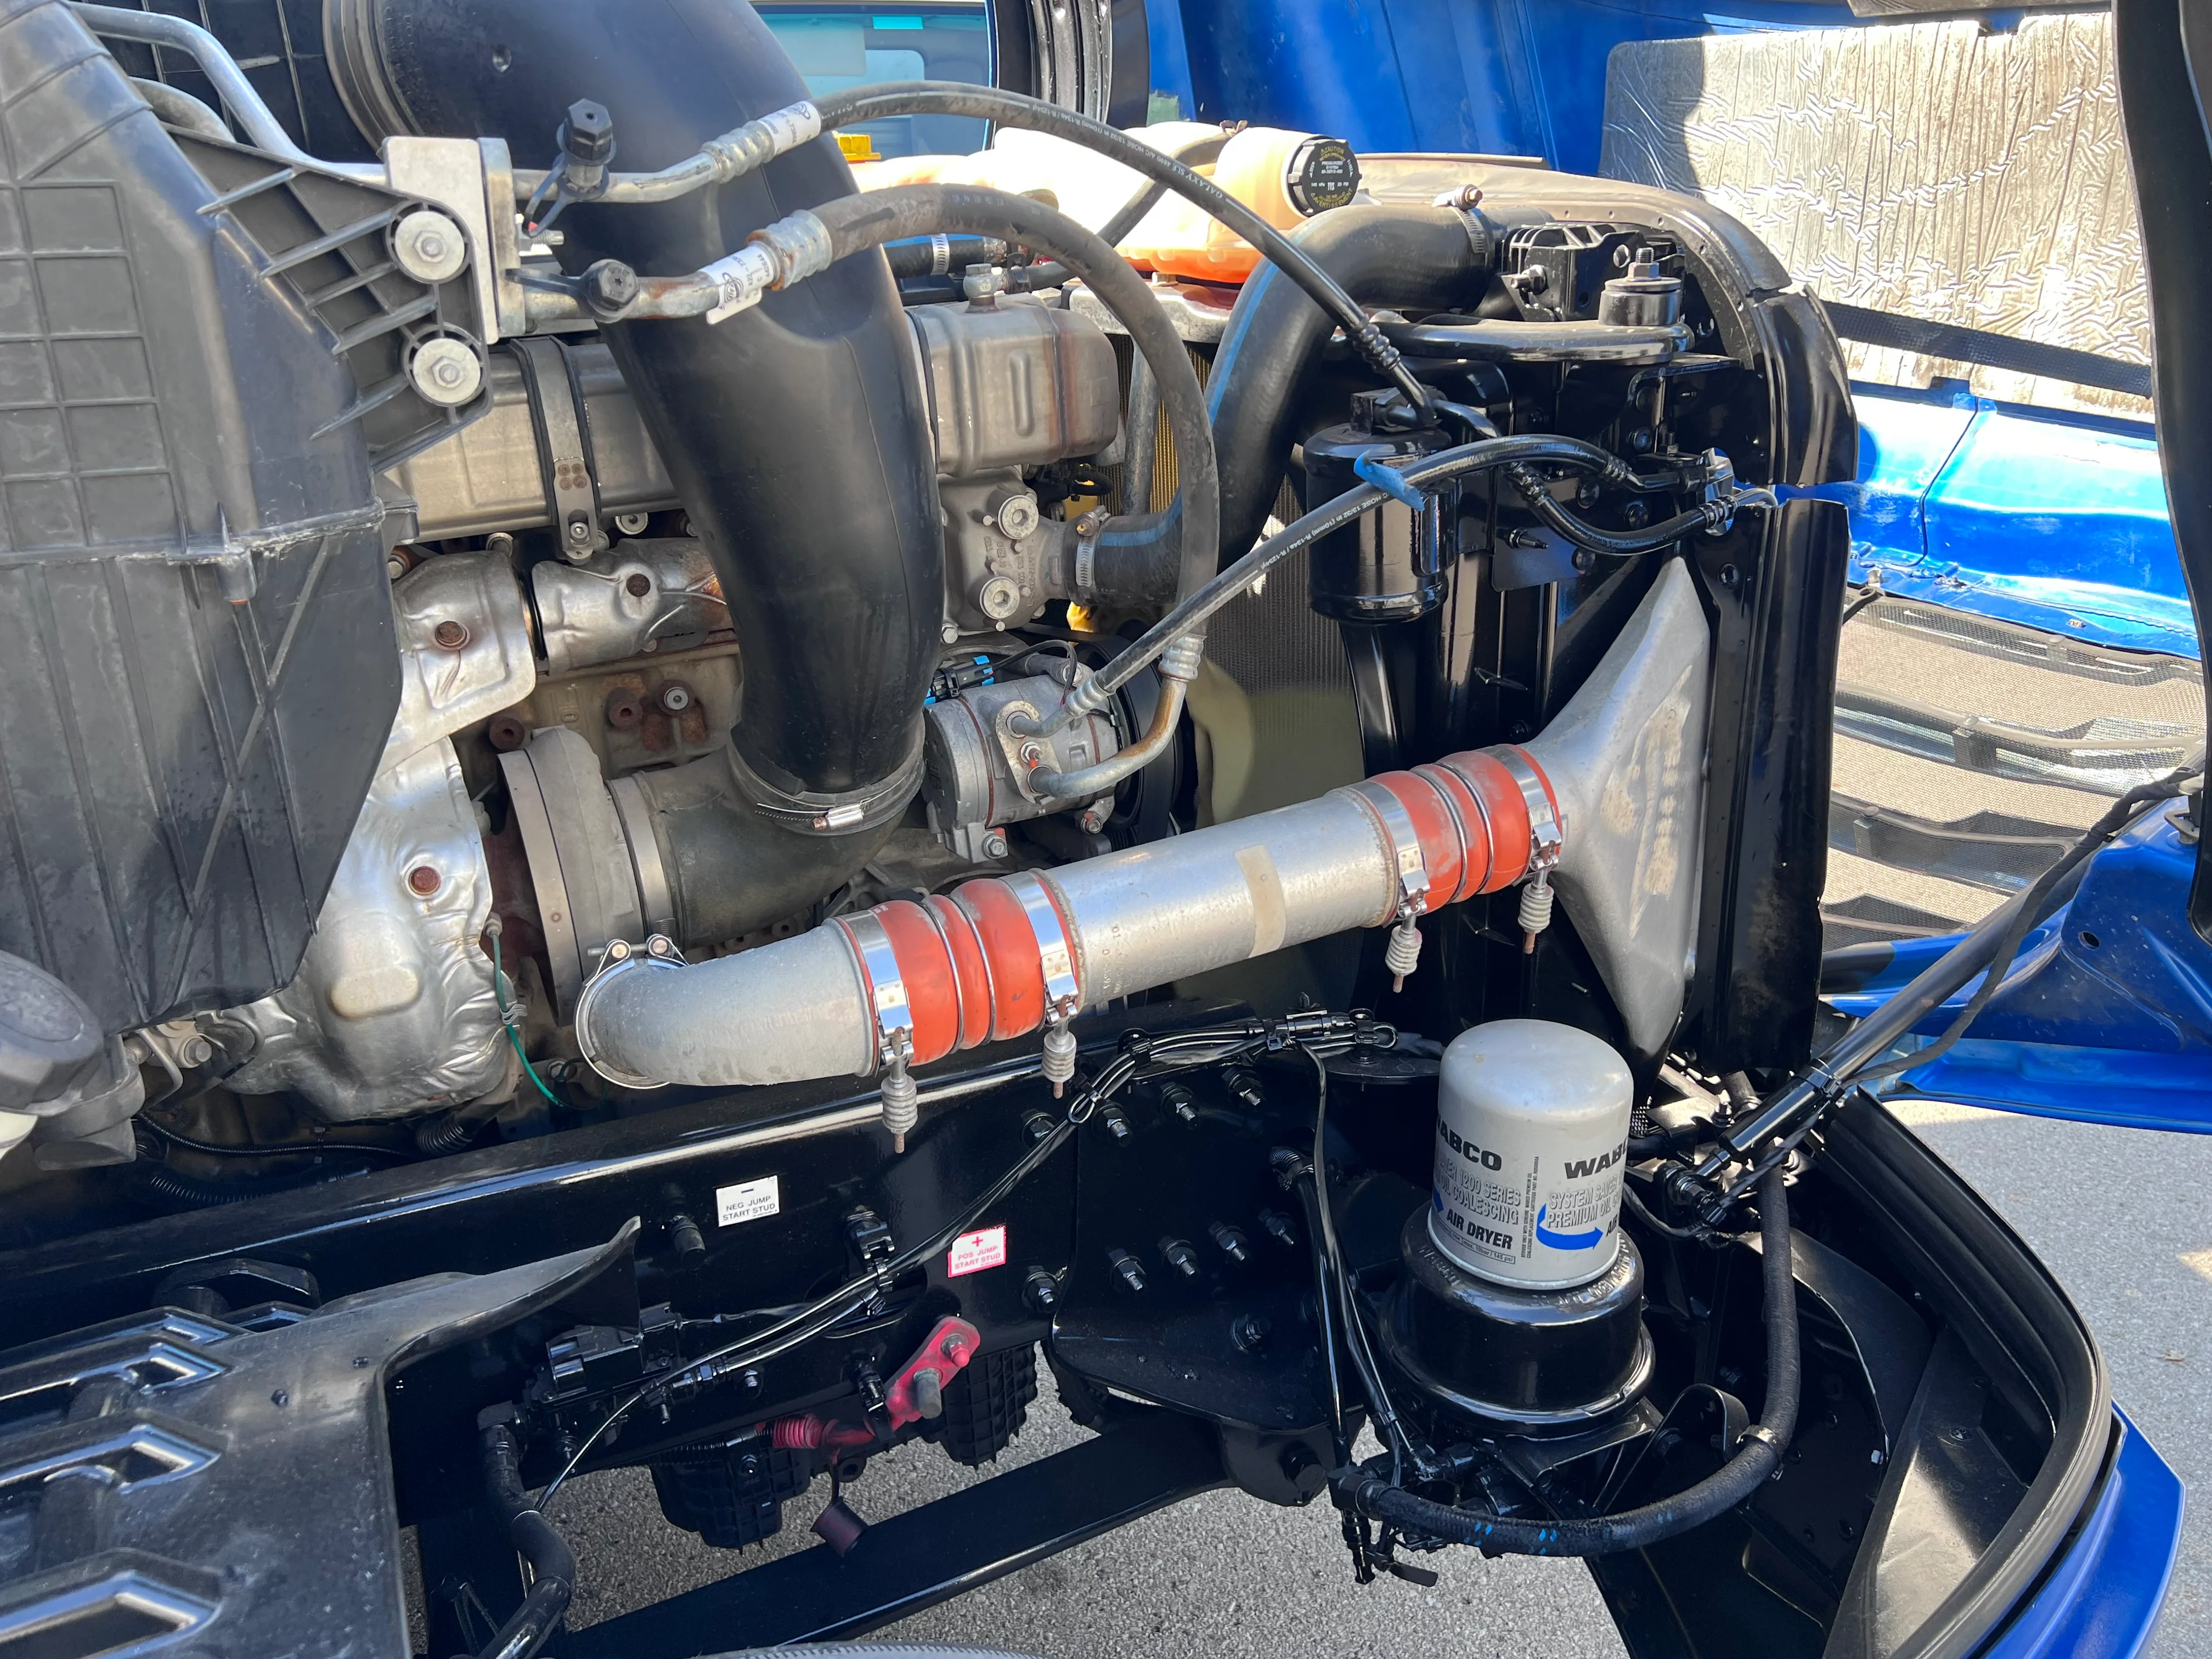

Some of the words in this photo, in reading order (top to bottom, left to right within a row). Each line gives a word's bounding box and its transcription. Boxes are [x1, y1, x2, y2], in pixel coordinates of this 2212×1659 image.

[1126, 140, 1144, 153] HOSE
[1145, 149, 1155, 159] A/C
[1324, 146, 1345, 155] CAUTION
[1156, 156, 1171, 167] 4890
[1172, 164, 1185, 176] SLE
[1186, 173, 1223, 199] GALAXY
[1362, 495, 1382, 509] HOSE
[1343, 506, 1361, 519] 13/32
[1311, 518, 1335, 537] (10mm)
[1437, 1114, 1502, 1171] ABCO
[1564, 1136, 1628, 1180] WAB
[1459, 1169, 1481, 1194] 1200
[1483, 1180, 1521, 1206] SERIES
[1549, 1186, 1594, 1210] SYSTEM
[1594, 1173, 1618, 1202] SAVER
[723, 1209, 750, 1221] START
[753, 1203, 775, 1214] STUD
[726, 1201, 744, 1212] NEG
[748, 1195, 771, 1206] JUMP
[1453, 1183, 1519, 1225] COALESCING
[1546, 1203, 1599, 1229] PREMIUM
[1599, 1197, 1611, 1217] OIL
[1446, 1208, 1464, 1232] AIR
[1466, 1221, 1513, 1250] DRYER
[955, 1259, 979, 1269] START
[981, 1252, 1001, 1262] STUD
[958, 1252, 974, 1261] POS
[977, 1245, 997, 1256] JUMP
[1494, 1251, 1503, 1260] 145
